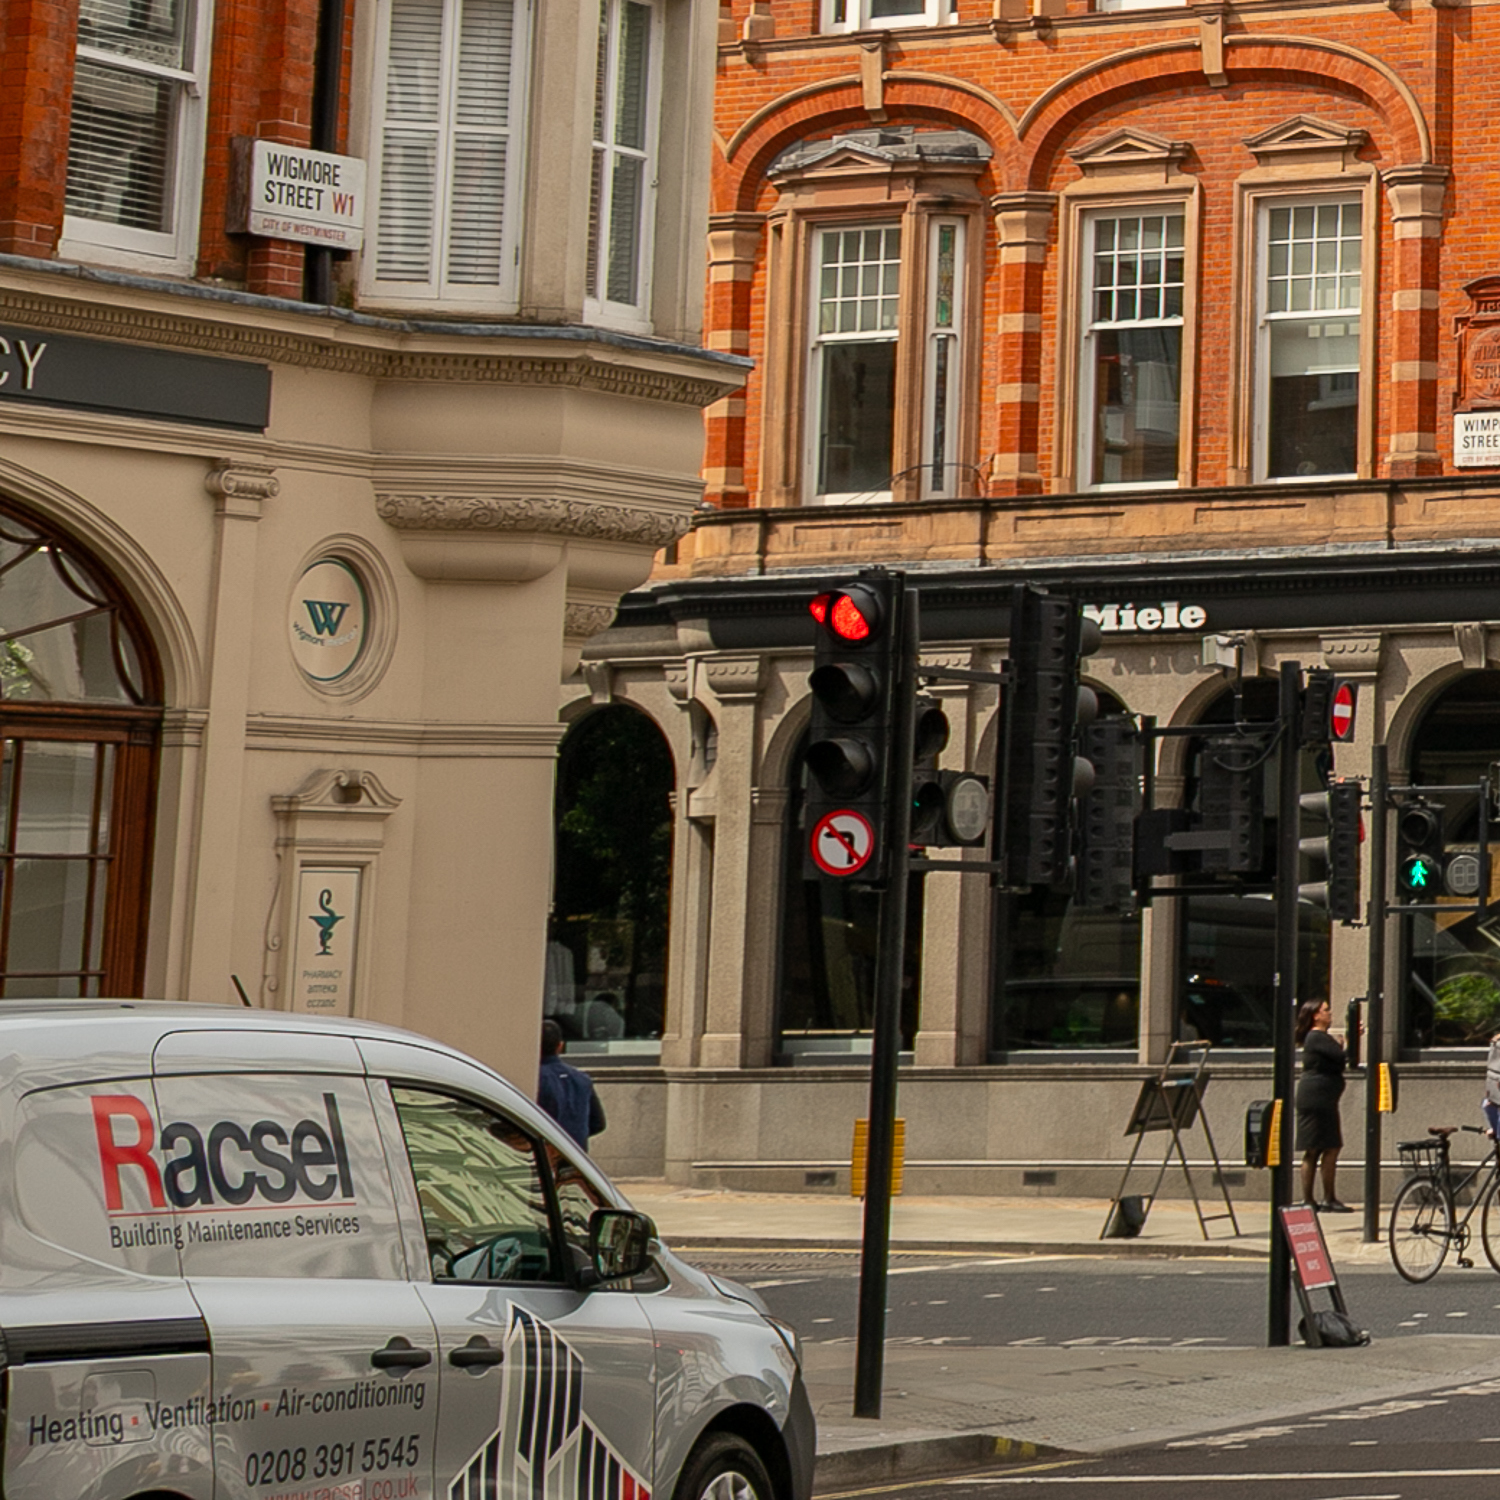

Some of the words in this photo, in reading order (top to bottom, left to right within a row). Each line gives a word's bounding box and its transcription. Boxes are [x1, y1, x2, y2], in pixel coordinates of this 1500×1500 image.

[267, 152, 341, 187] WIGMORE
[264, 180, 324, 211] STREET
[332, 191, 354, 217] W1
[262, 218, 279, 230] CITY
[281, 221, 292, 232] OF
[293, 223, 346, 242] WESTMINSTER
[303, 600, 350, 636] W
[1082, 601, 1207, 631] Miele
[302, 969, 343, 979] PHARMACY
[91, 1093, 355, 1210] Racsel
[110, 1223, 185, 1250] Building
[187, 1218, 291, 1243] Maintenance
[295, 1213, 360, 1237] Services
[29, 1409, 124, 1446] Heating
[145, 1395, 256, 1430] Ventilation
[275, 1378, 425, 1418] Air-conditioning
[245, 1447, 307, 1488] 0208
[313, 1442, 355, 1479] 391
[361, 1434, 420, 1473] 5545
